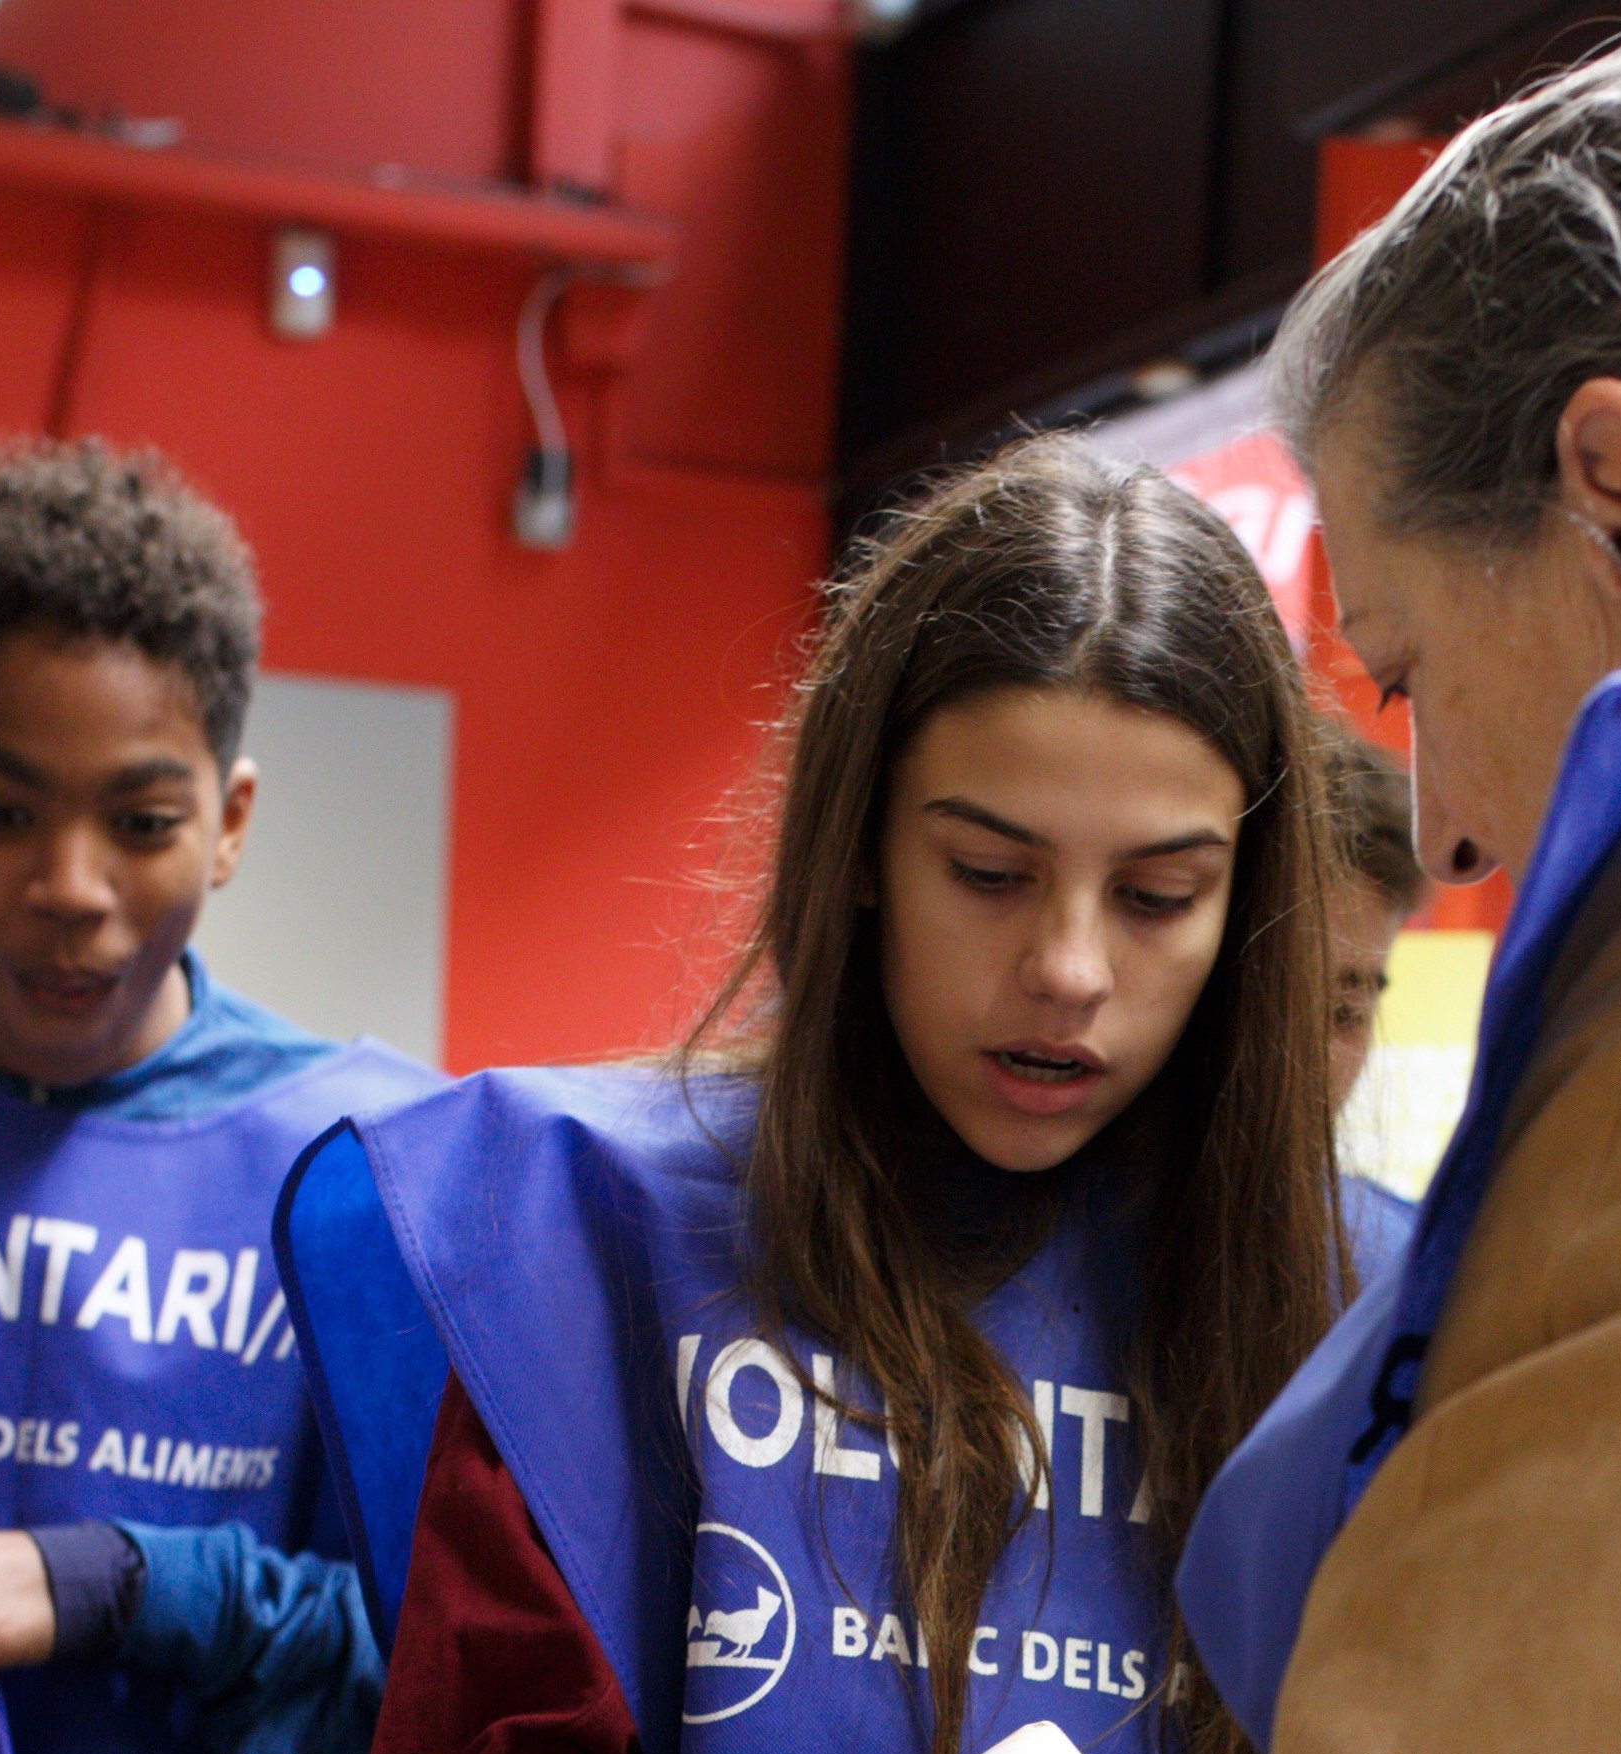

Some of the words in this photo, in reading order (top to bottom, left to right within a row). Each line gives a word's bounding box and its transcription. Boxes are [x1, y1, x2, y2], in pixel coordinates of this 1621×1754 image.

[90, 1428, 281, 1492] ALIMENTS
[832, 1607, 998, 1676] BAC
[1021, 1630, 1147, 1701] DELS
